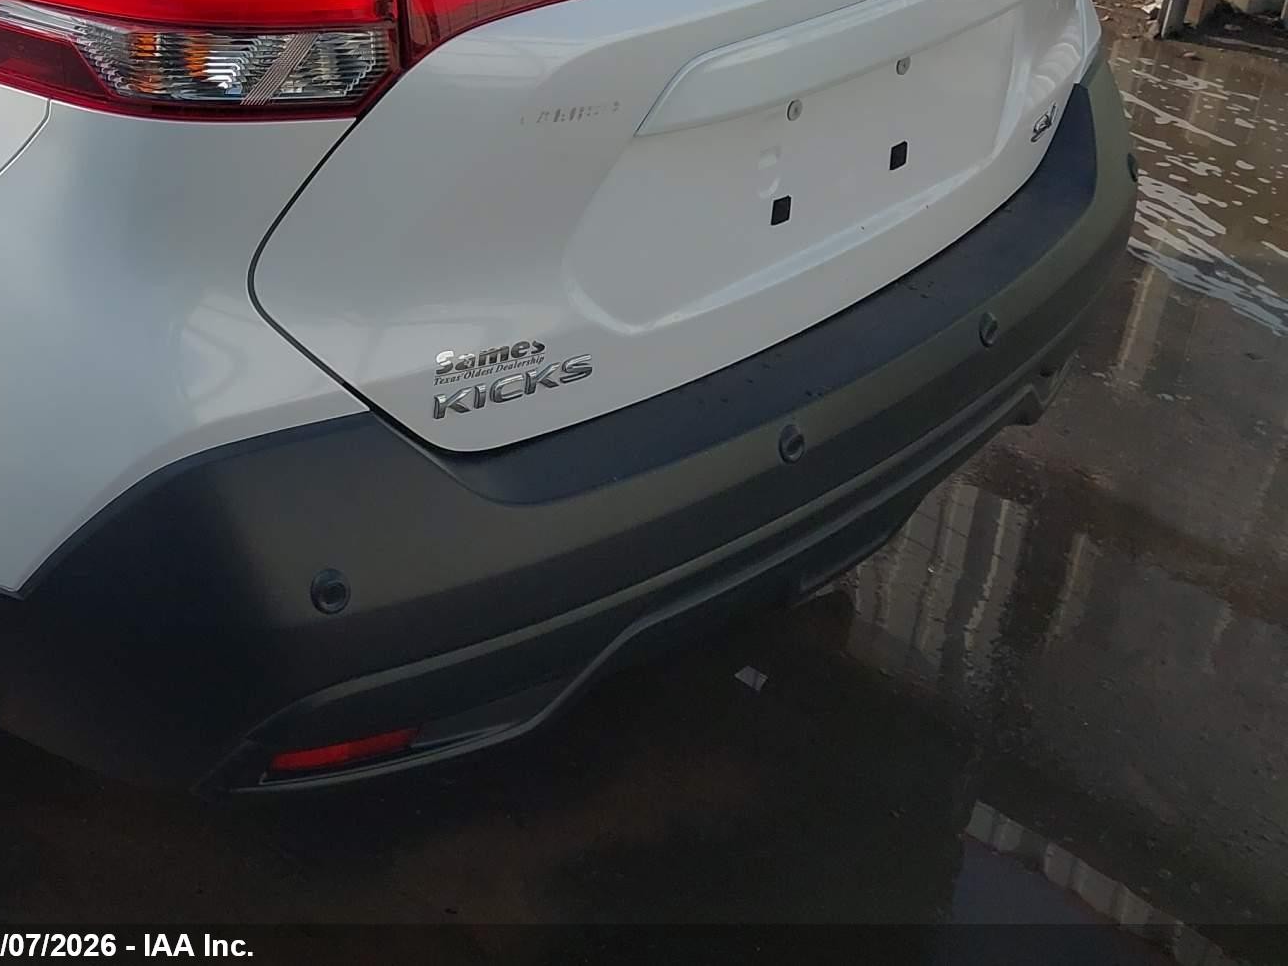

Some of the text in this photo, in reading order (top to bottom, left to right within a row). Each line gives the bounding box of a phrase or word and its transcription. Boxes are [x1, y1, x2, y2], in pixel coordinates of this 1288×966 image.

[433, 355, 546, 386] Texas Oldest Dealership
[435, 341, 546, 375] Sames
[433, 354, 593, 420] KICKS
